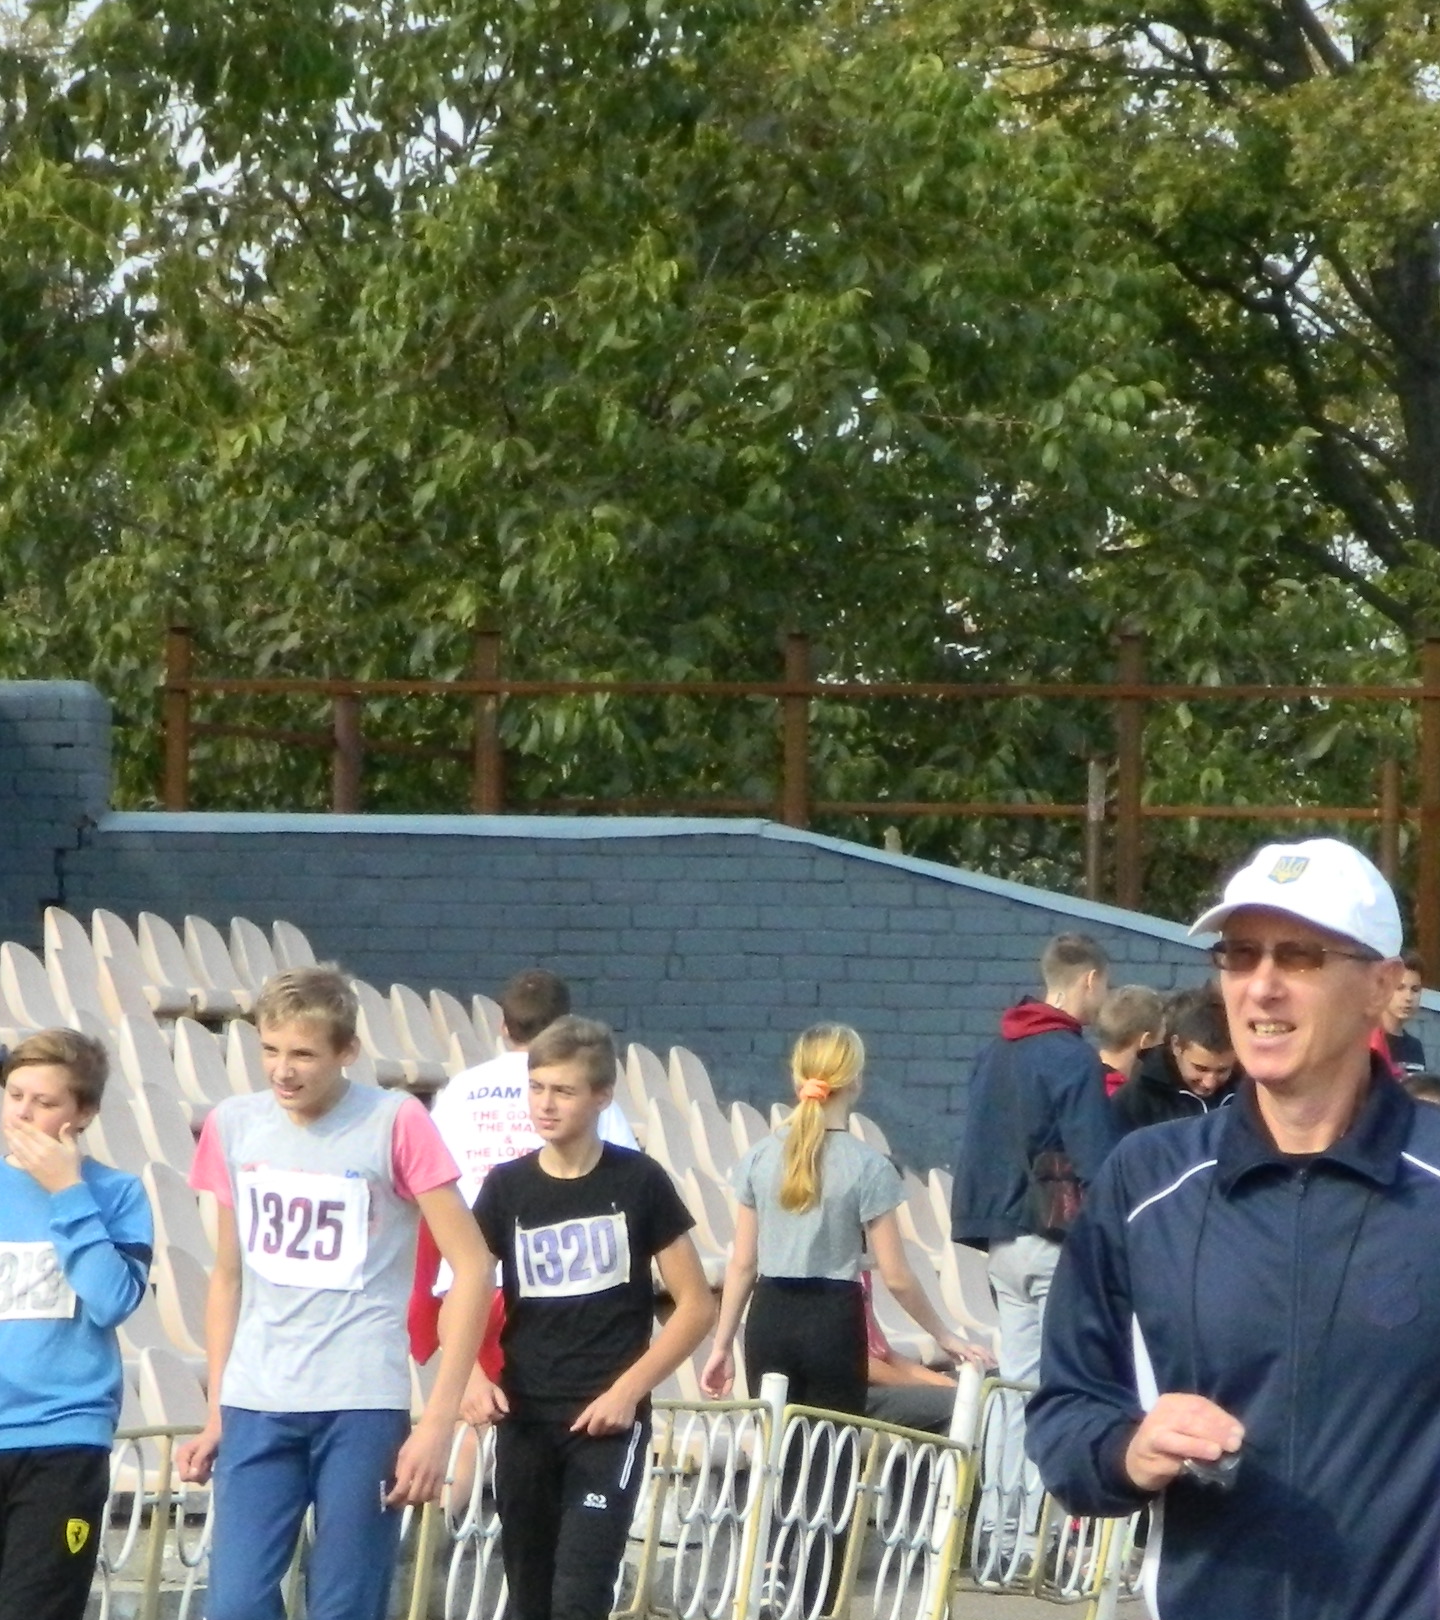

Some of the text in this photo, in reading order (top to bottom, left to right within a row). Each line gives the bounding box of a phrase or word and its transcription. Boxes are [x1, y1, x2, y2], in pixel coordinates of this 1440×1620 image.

[467, 1086, 522, 1101] ADAM
[478, 1122, 536, 1133] THE MA
[466, 1147, 492, 1160] THE
[247, 1187, 346, 1262] 1325
[519, 1217, 619, 1287] 1320
